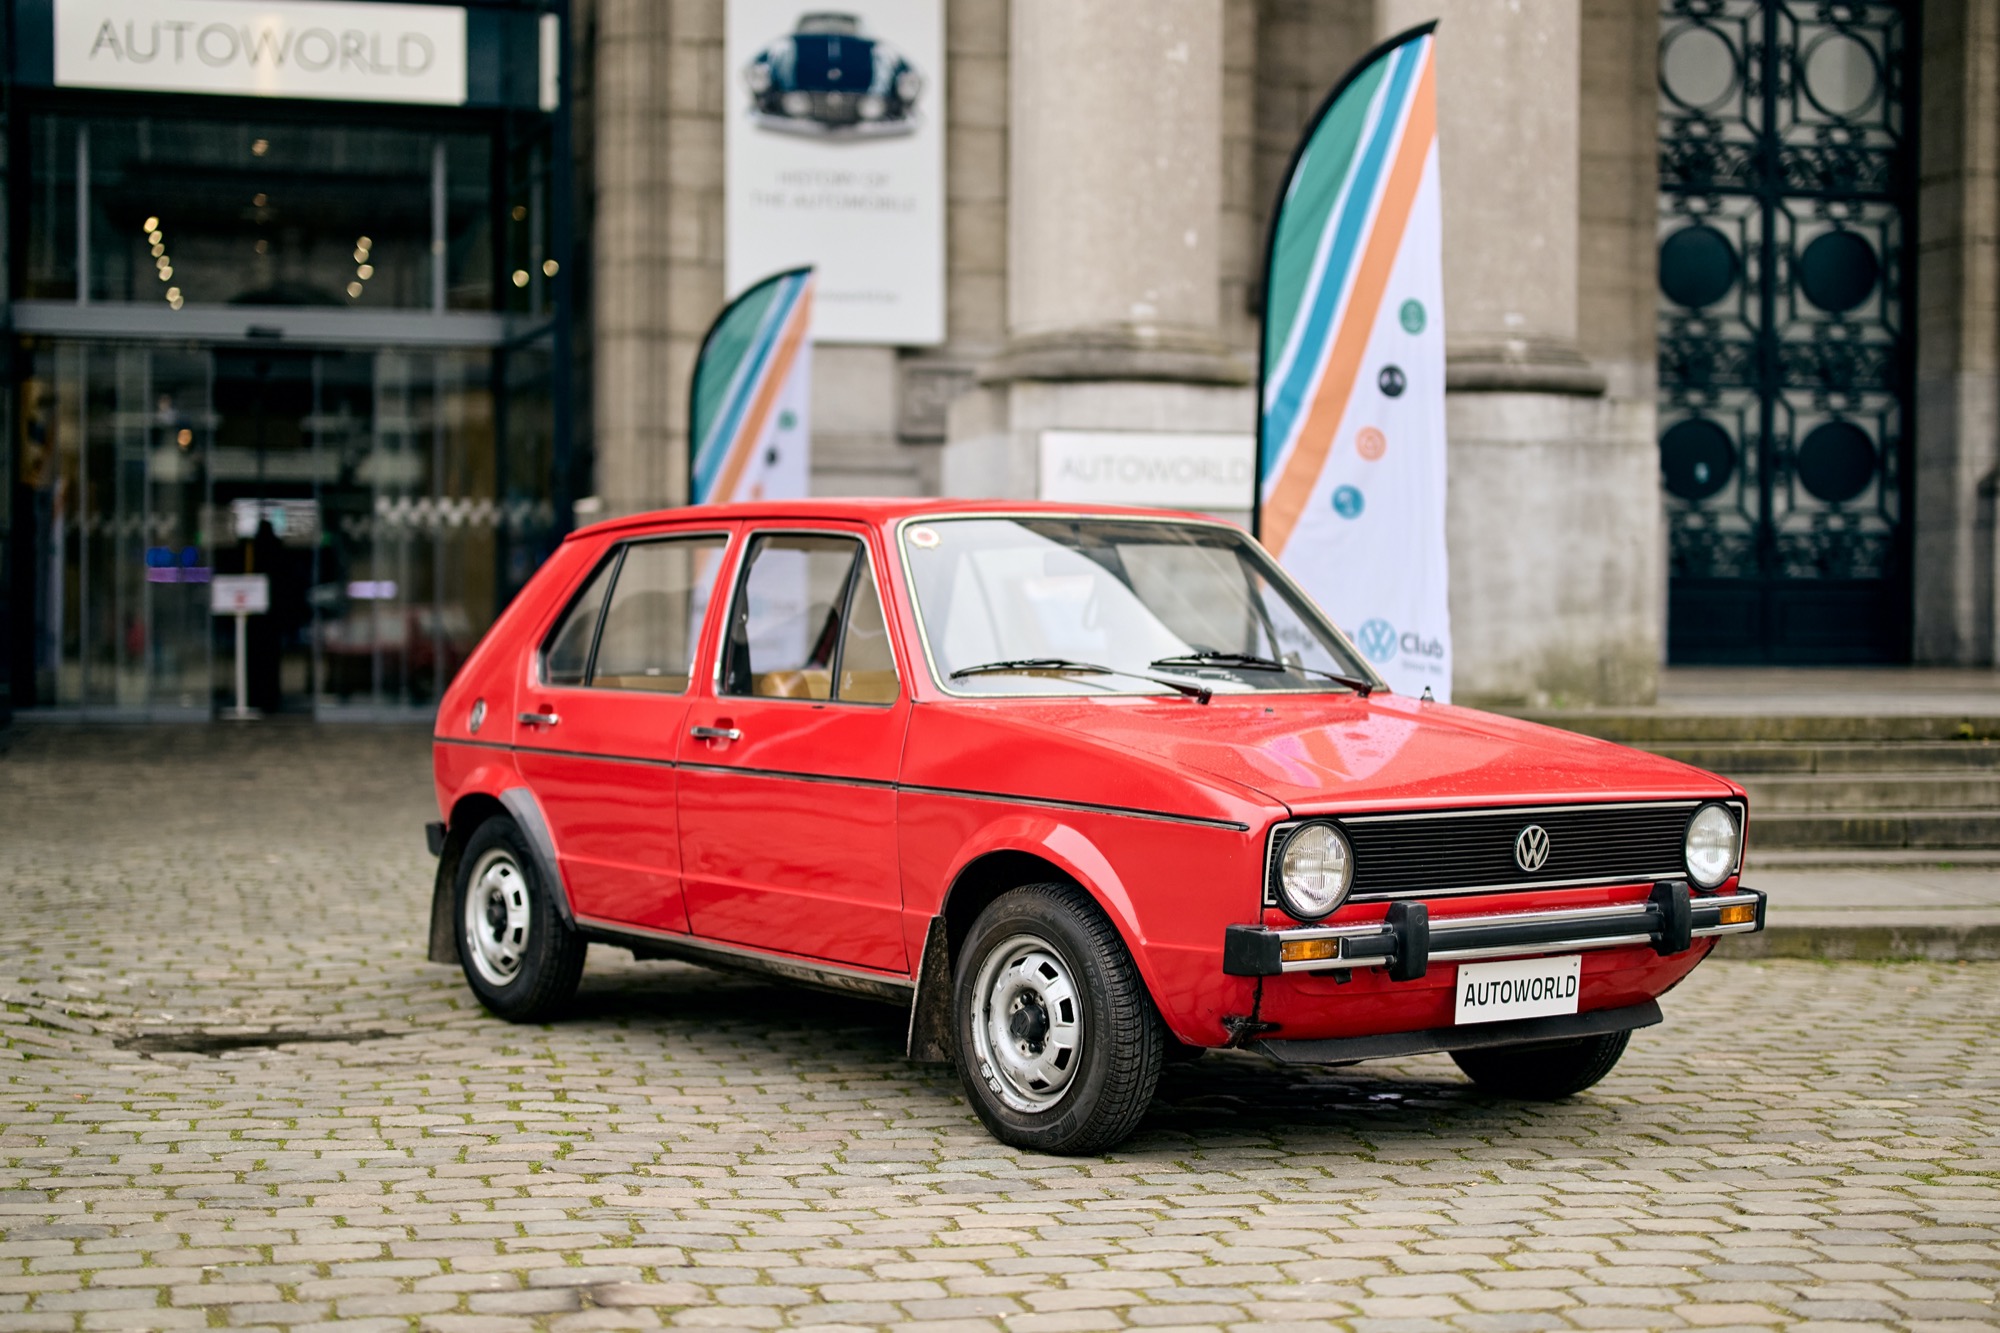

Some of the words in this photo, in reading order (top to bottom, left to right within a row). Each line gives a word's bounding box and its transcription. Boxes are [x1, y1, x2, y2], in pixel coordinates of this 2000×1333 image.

[90, 18, 435, 76] AUTOWORLD
[1059, 452, 1253, 486] AUTOWORLD
[1400, 631, 1444, 659] Club
[1464, 975, 1577, 1008] AUTOWORLD
